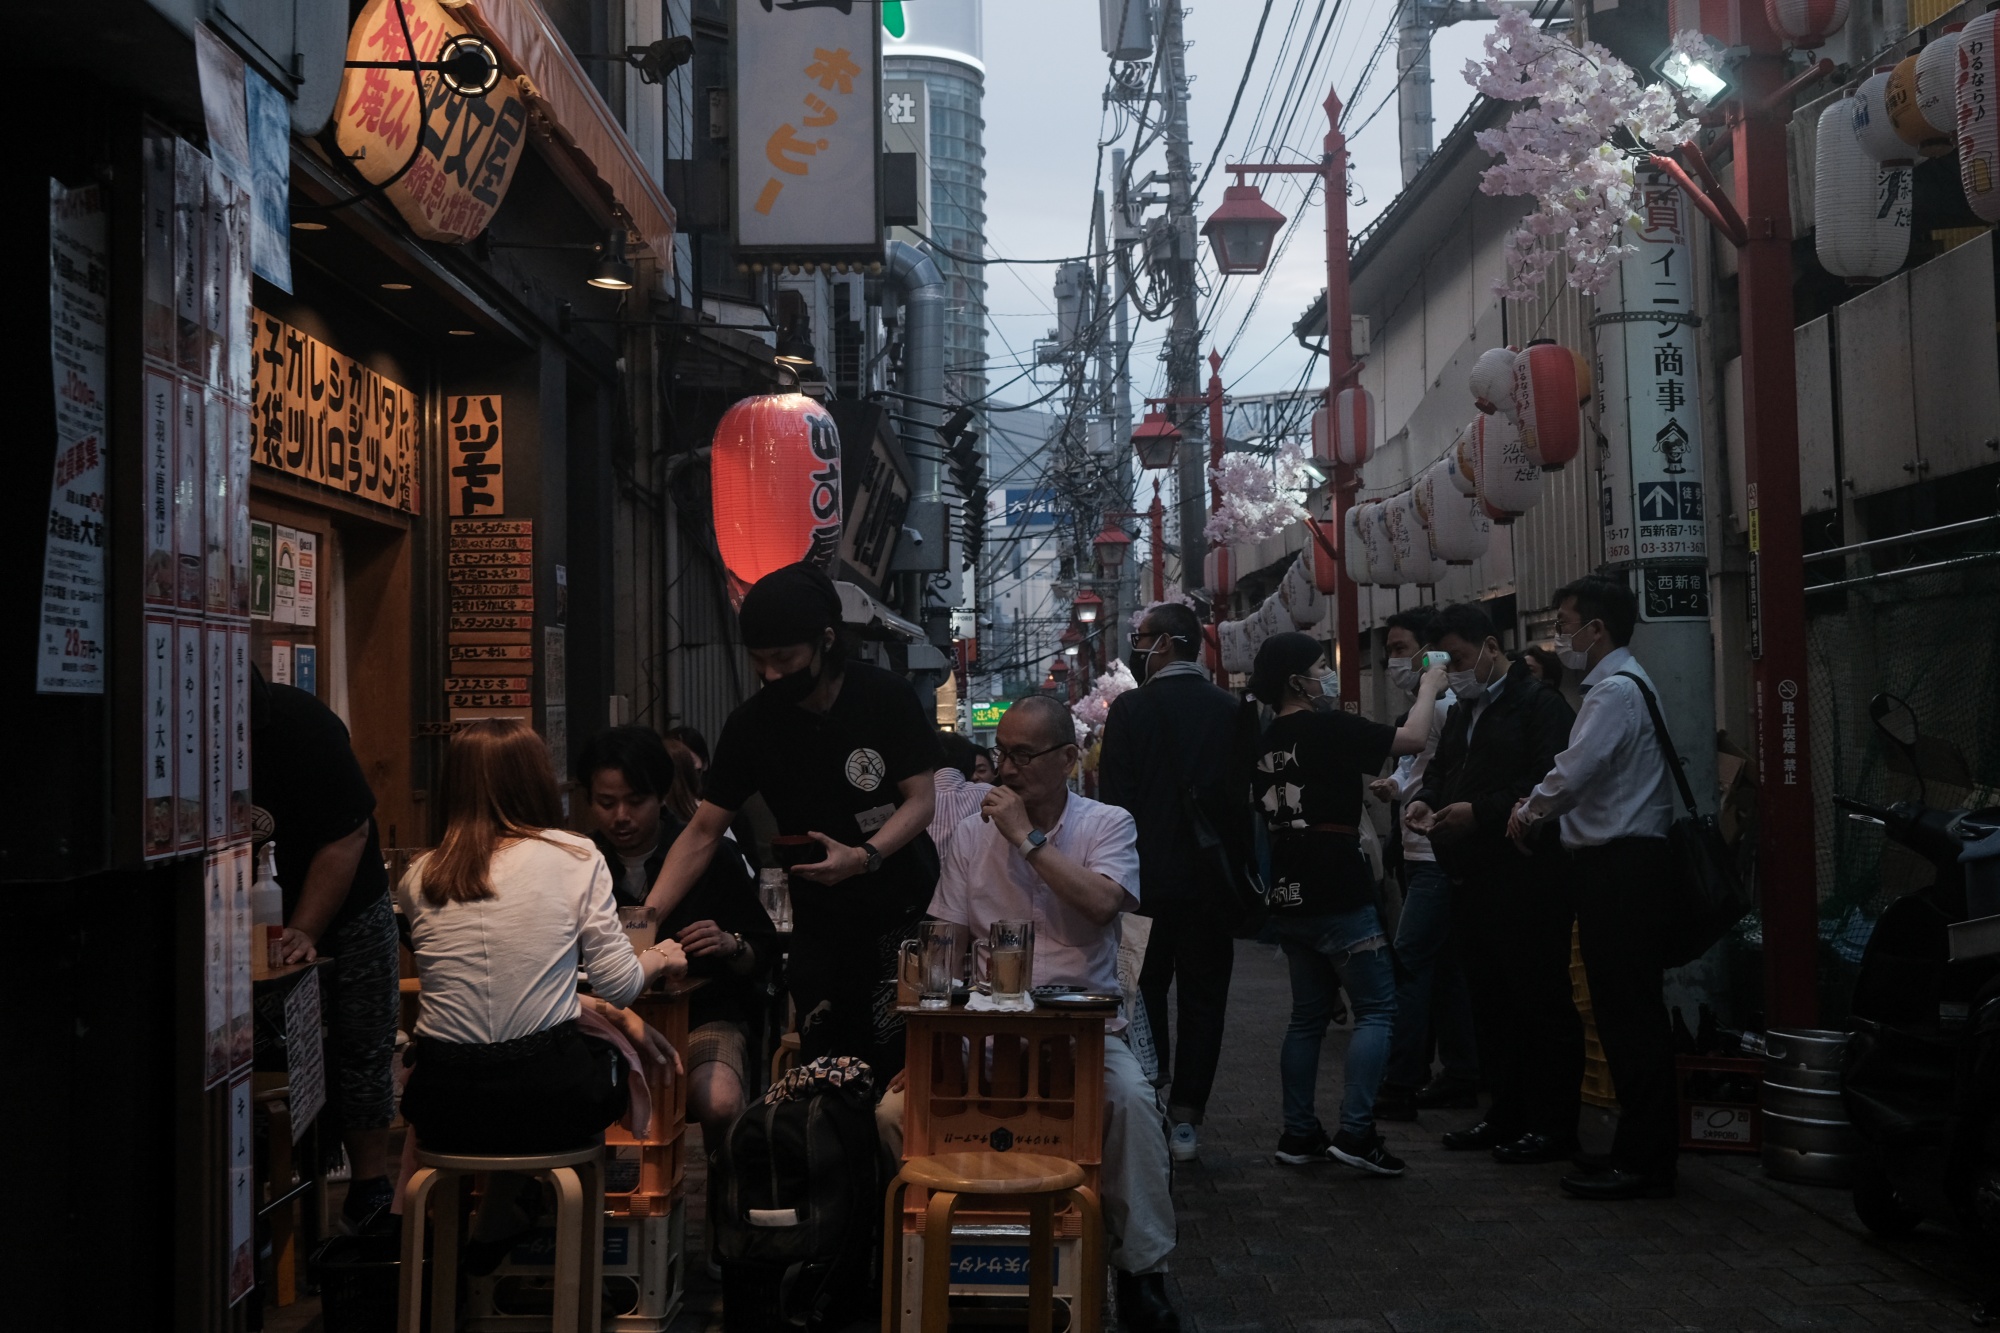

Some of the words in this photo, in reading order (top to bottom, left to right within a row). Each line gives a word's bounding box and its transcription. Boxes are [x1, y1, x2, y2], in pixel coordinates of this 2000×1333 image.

[754, 47, 862, 216] ホッピー
[451, 397, 500, 516] ハツモト
[1658, 575, 1701, 590] 西新宿
[155, 637, 166, 780] ビール大瓶
[1781, 701, 1797, 754] 路上喫煙
[1784, 758, 1798, 785] 禁止
[626, 920, 648, 929] Asahi
